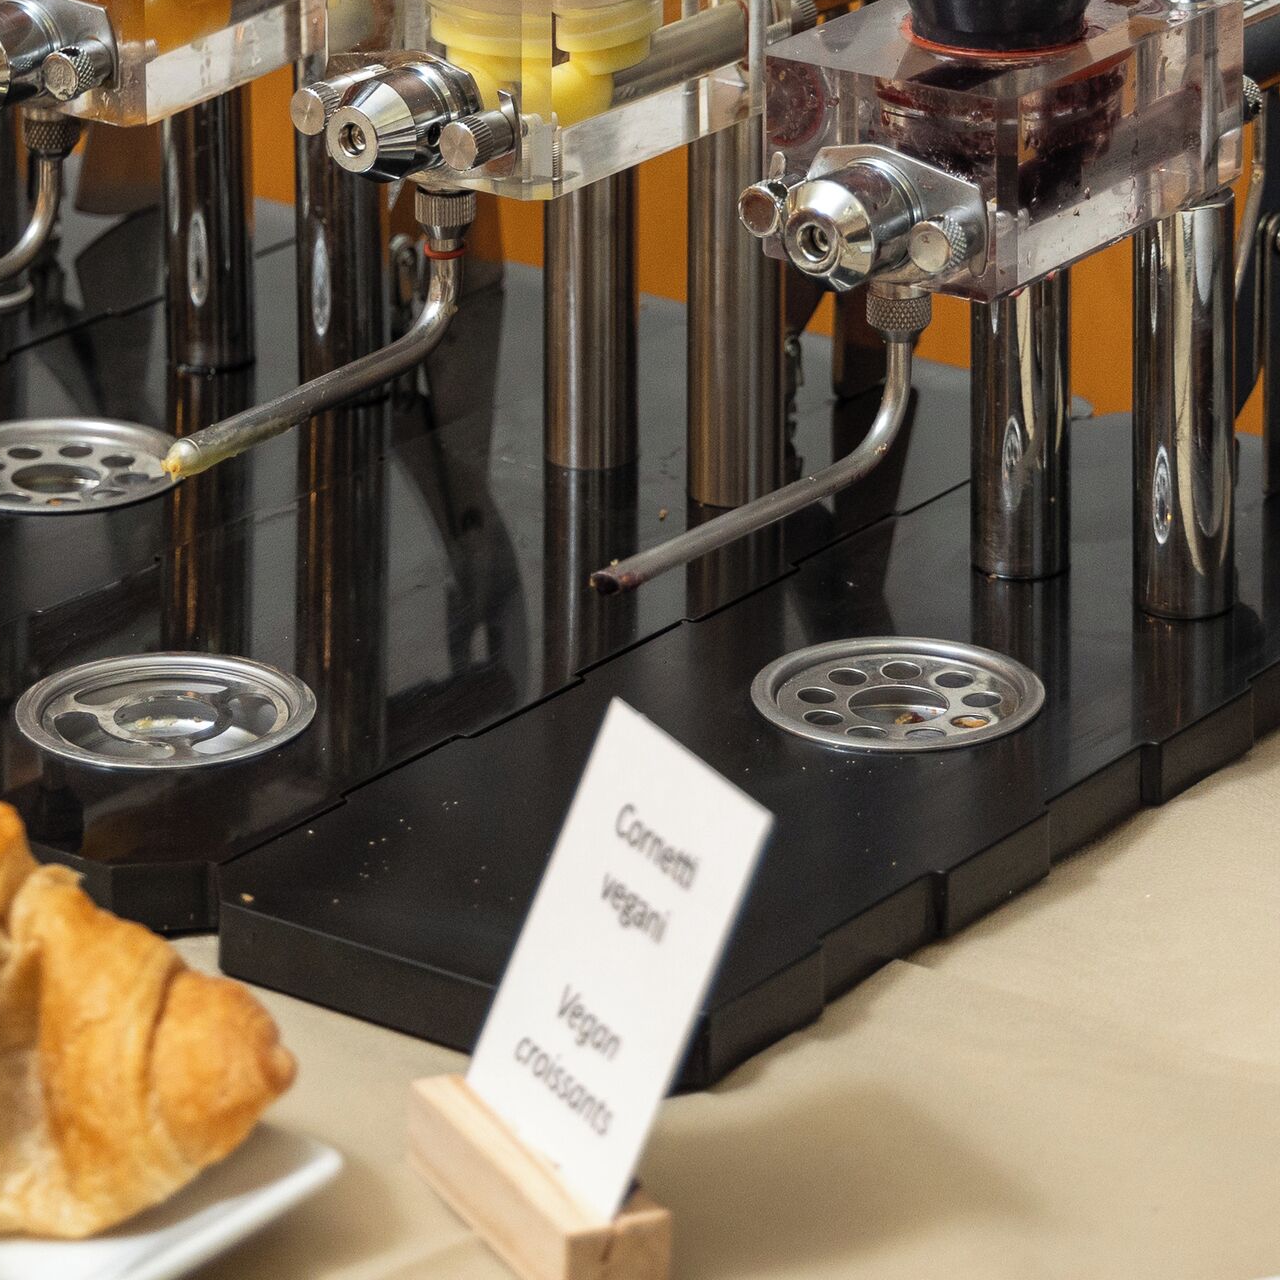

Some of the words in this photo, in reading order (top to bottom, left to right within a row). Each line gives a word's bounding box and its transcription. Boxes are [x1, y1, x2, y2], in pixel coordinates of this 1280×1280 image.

[614, 802, 702, 892] Cornetti
[600, 871, 670, 946] vegani
[556, 983, 624, 1063] Vegan
[513, 1033, 615, 1137] croissants
